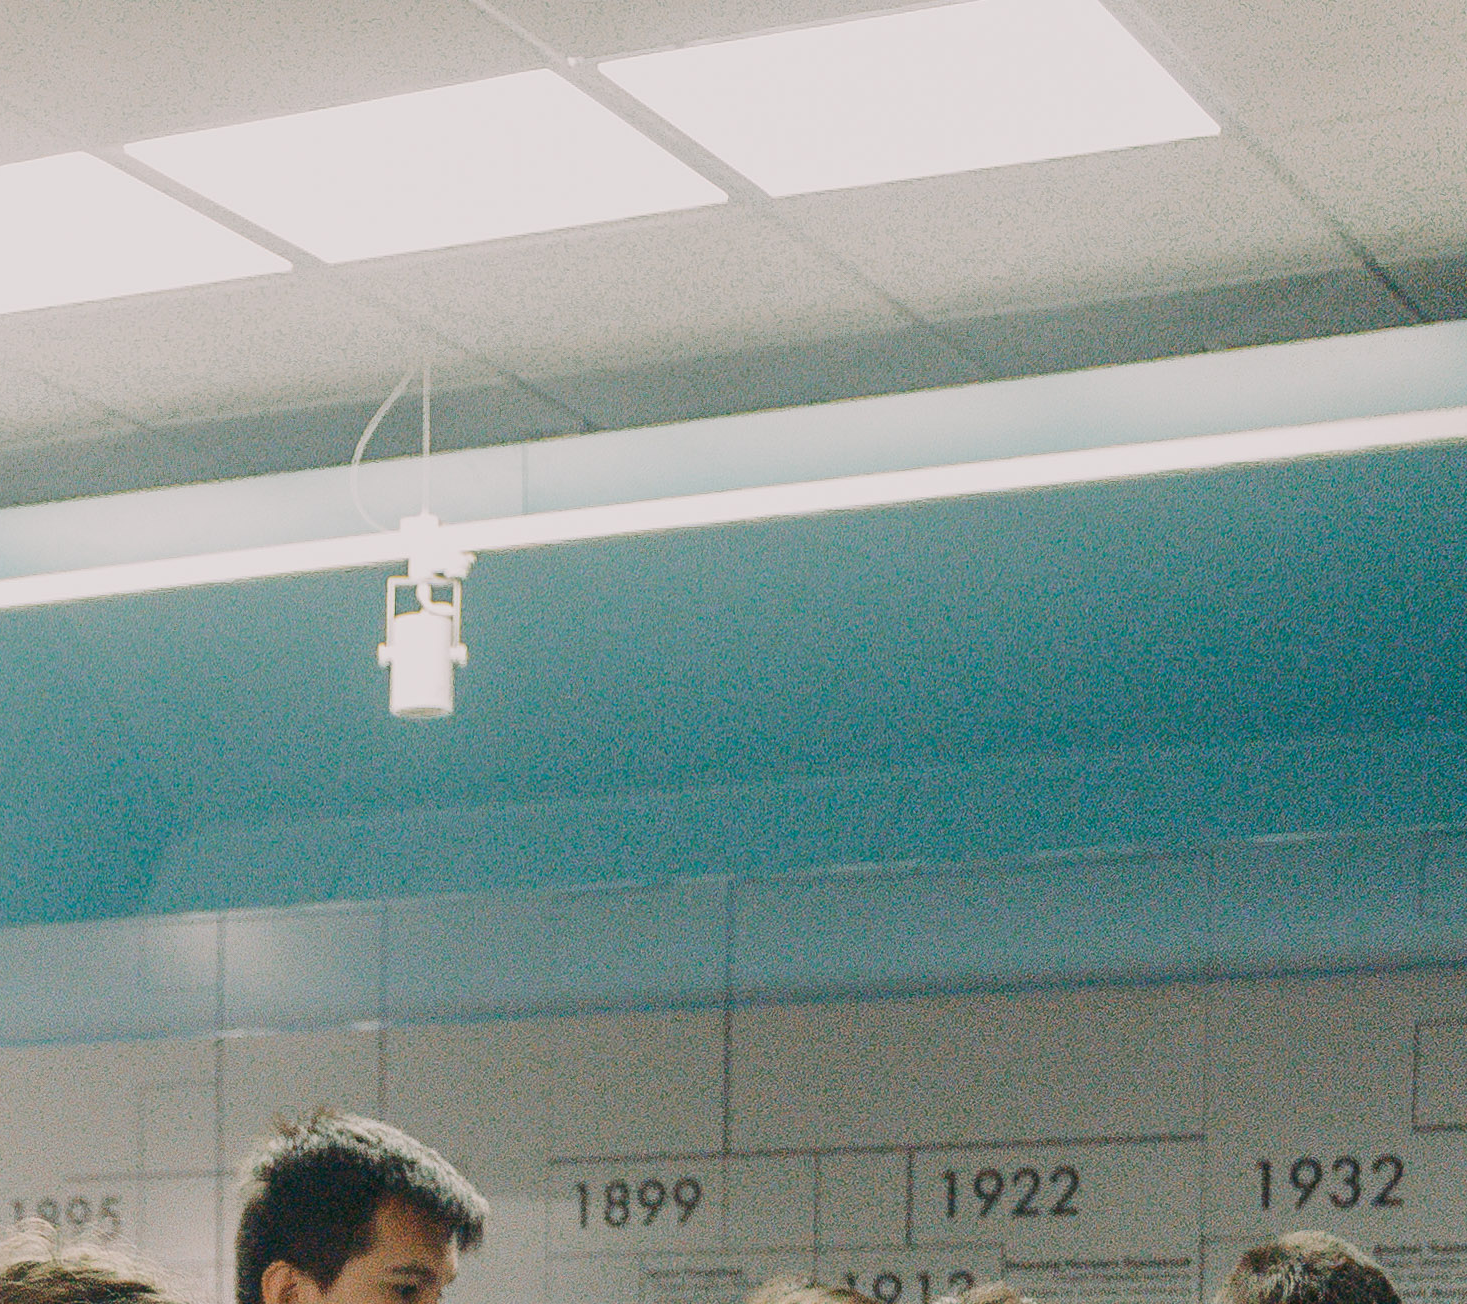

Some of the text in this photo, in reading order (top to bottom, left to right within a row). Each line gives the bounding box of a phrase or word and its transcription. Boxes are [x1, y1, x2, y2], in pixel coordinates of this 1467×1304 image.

[576, 1176, 704, 1228] 1899
[942, 1166, 1081, 1219] 1922
[1255, 1154, 1405, 1210] 1932
